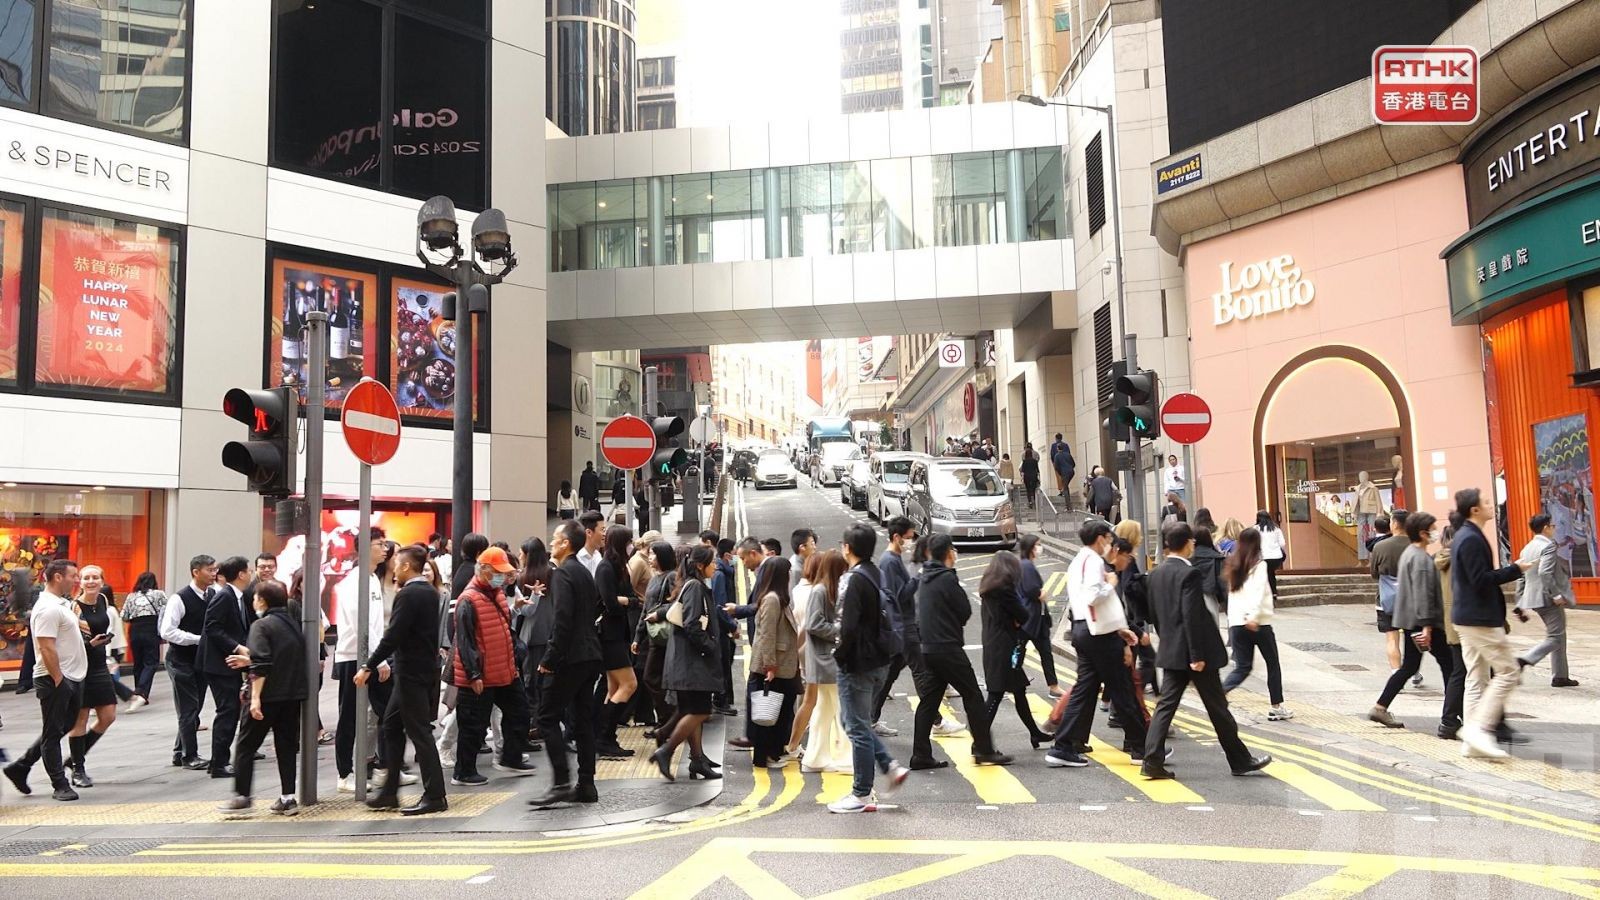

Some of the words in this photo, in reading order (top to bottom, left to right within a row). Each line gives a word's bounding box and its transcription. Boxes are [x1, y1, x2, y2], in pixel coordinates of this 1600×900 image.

[8, 140, 27, 162] &
[34, 145, 170, 191] SPENCER
[1160, 157, 1200, 182] Avanti
[1170, 176, 1185, 187] 2117
[73, 256, 141, 280] 恭賀新禧
[1476, 247, 1529, 284] 英皇戲院
[83, 279, 128, 294] HAPPY
[82, 293, 128, 309] LUNAR
[1213, 279, 1315, 326] Bonito
[90, 310, 120, 323] NEW
[86, 324, 123, 338] YEAR
[85, 340, 123, 353] 2024
